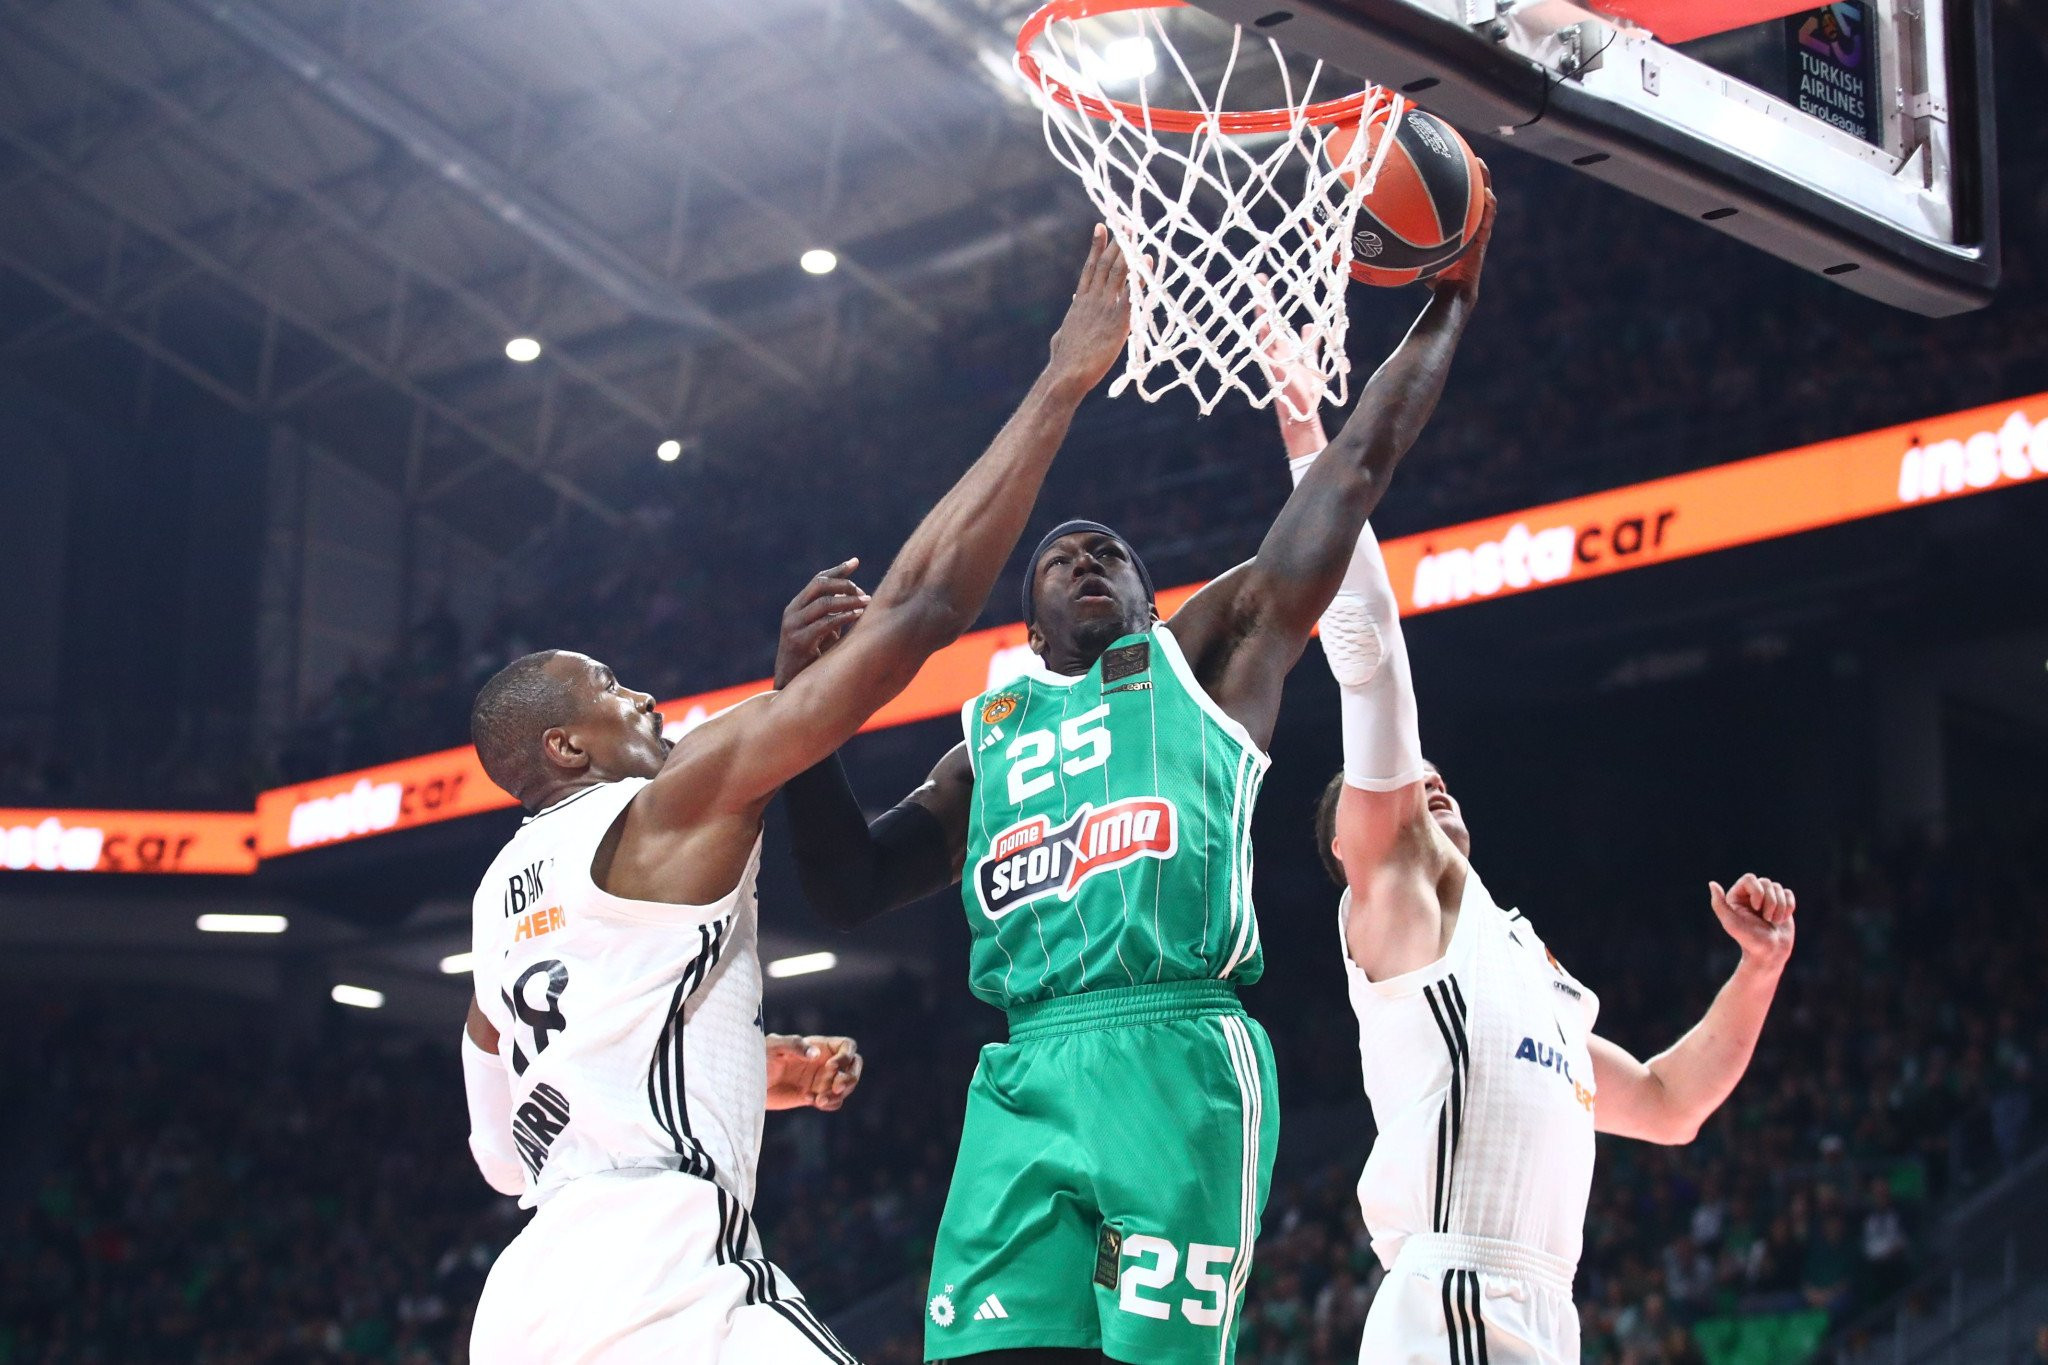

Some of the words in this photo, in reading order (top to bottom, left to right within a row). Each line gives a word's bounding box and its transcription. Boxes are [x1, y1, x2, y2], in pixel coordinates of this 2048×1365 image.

[1800, 51, 1864, 97] TURKISH
[1800, 74, 1866, 118] AIRLINES
[1006, 703, 1111, 805] 25
[999, 825, 1039, 859] pame
[505, 858, 554, 919] IBAK
[1118, 1233, 1236, 1327] 25
